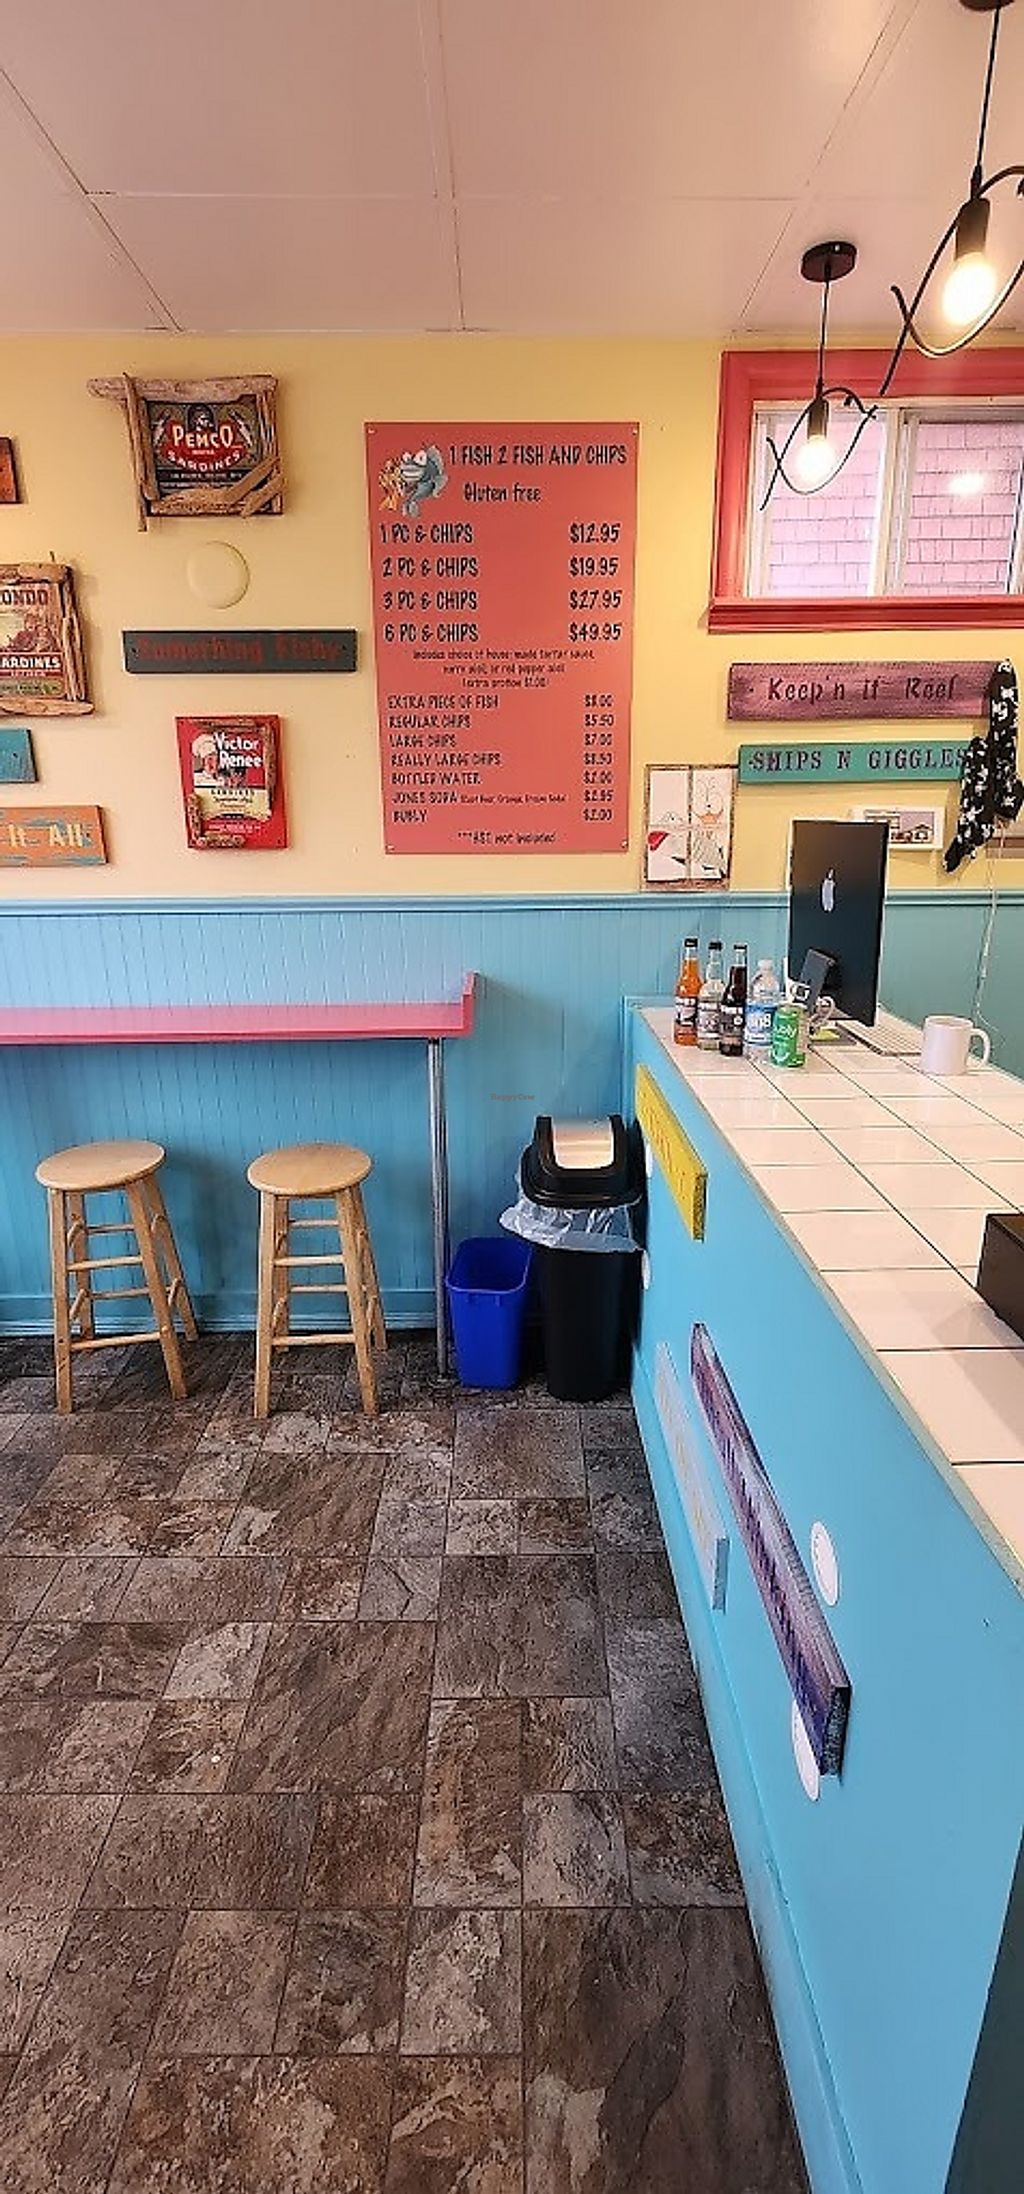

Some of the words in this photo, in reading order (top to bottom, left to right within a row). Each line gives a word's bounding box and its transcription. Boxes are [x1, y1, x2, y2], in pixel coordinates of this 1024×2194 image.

[450, 445, 455, 464] 1
[462, 445, 492, 465] FISH
[498, 445, 507, 464] 2
[513, 445, 544, 465] FISH
[549, 445, 581, 465] AND
[586, 445, 627, 465] CHIPS
[464, 482, 508, 502] Gluten
[513, 482, 541, 502] free
[381, 524, 387, 543] 1
[391, 524, 410, 543] PC
[415, 524, 427, 543] &
[430, 524, 473, 543] CHIPS
[570, 523, 621, 543] $12.95
[383, 557, 392, 577] 2
[398, 557, 416, 577] PC
[421, 557, 431, 577] &
[436, 557, 479, 577] CHIPS
[569, 557, 619, 576] $19.95
[383, 590, 393, 610] 3
[398, 590, 415, 610] PC
[421, 590, 431, 610] &
[436, 590, 478, 610] CHIPS
[569, 590, 623, 610] $27.95
[384, 623, 394, 642] 6
[400, 623, 416, 642] PC
[421, 623, 433, 642] &
[437, 623, 479, 642] CHIPS
[568, 623, 622, 642] $49.95
[501, 663, 515, 673] red
[767, 676, 846, 705] Keep'n
[904, 674, 959, 700] Reel
[387, 695, 425, 708] EXTRA
[428, 695, 455, 708] PIECE
[460, 695, 472, 708] OF
[475, 695, 498, 708] FISH
[389, 714, 440, 728] REGULAR
[441, 714, 471, 728] CHIPS
[584, 714, 614, 726] $5.50
[214, 732, 260, 751] Victor
[389, 733, 423, 748] LARGE
[428, 733, 456, 748] CHIPS
[584, 733, 612, 746] $7.00
[219, 750, 262, 769] Renee
[391, 753, 431, 766] REALLY
[435, 753, 469, 766] LARGE
[472, 753, 501, 766] CHIPS
[750, 750, 822, 772] SHIPS
[837, 750, 852, 770] N
[868, 747, 967, 770] GIGGLES
[392, 772, 437, 785] BOTTLED
[439, 772, 481, 785] WATER
[392, 791, 426, 804] JONES
[429, 791, 458, 804] SODA
